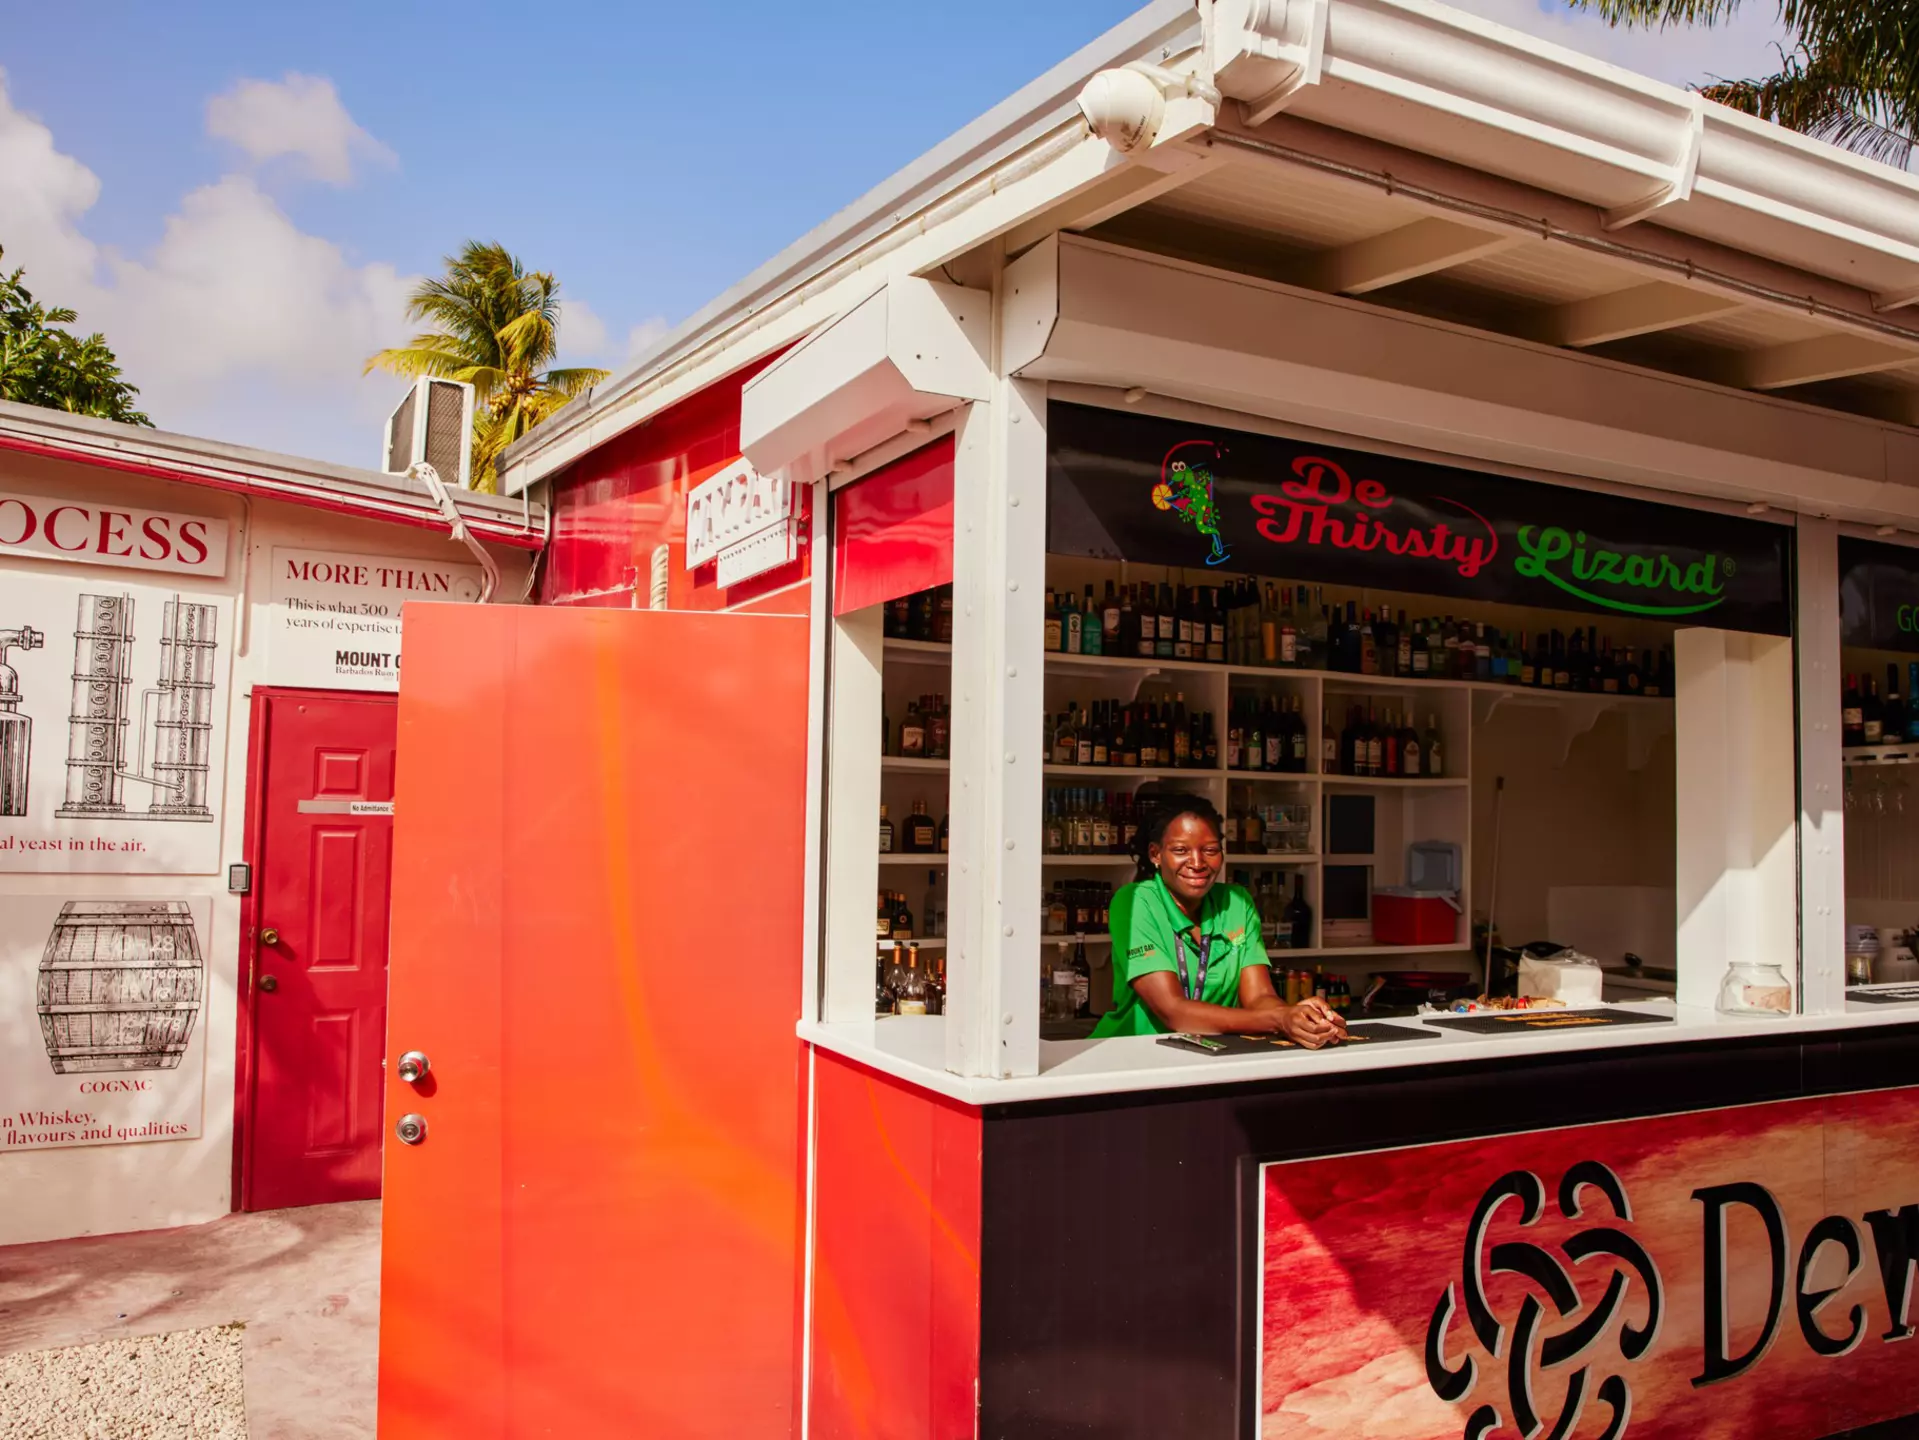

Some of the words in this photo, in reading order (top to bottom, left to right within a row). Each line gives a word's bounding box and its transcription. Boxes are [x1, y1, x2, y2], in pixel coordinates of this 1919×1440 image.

[1281, 456, 1394, 508] De
[0, 499, 208, 565] OCESS
[1251, 494, 1498, 578] Thirsty
[286, 559, 369, 586] MORE
[376, 567, 450, 593] THAN
[1514, 524, 1727, 615] Lizard
[285, 597, 314, 611] This
[316, 599, 326, 612] is
[328, 601, 357, 615] what
[286, 616, 319, 630] years
[321, 617, 335, 629] of
[337, 620, 393, 634] expertise
[335, 649, 392, 669] MOUNT
[335, 665, 374, 676] Barbados
[352, 804, 360, 812] No
[361, 804, 389, 812] Admittance
[19, 839, 63, 853] yeast
[69, 837, 84, 850] in
[90, 837, 116, 851] the
[121, 838, 146, 851] air.
[79, 1079, 152, 1094] COGNAC
[19, 1109, 97, 1126] Whiskey,
[7, 1129, 76, 1145] flavours
[80, 1125, 112, 1140] and
[117, 1121, 188, 1141] qualities
